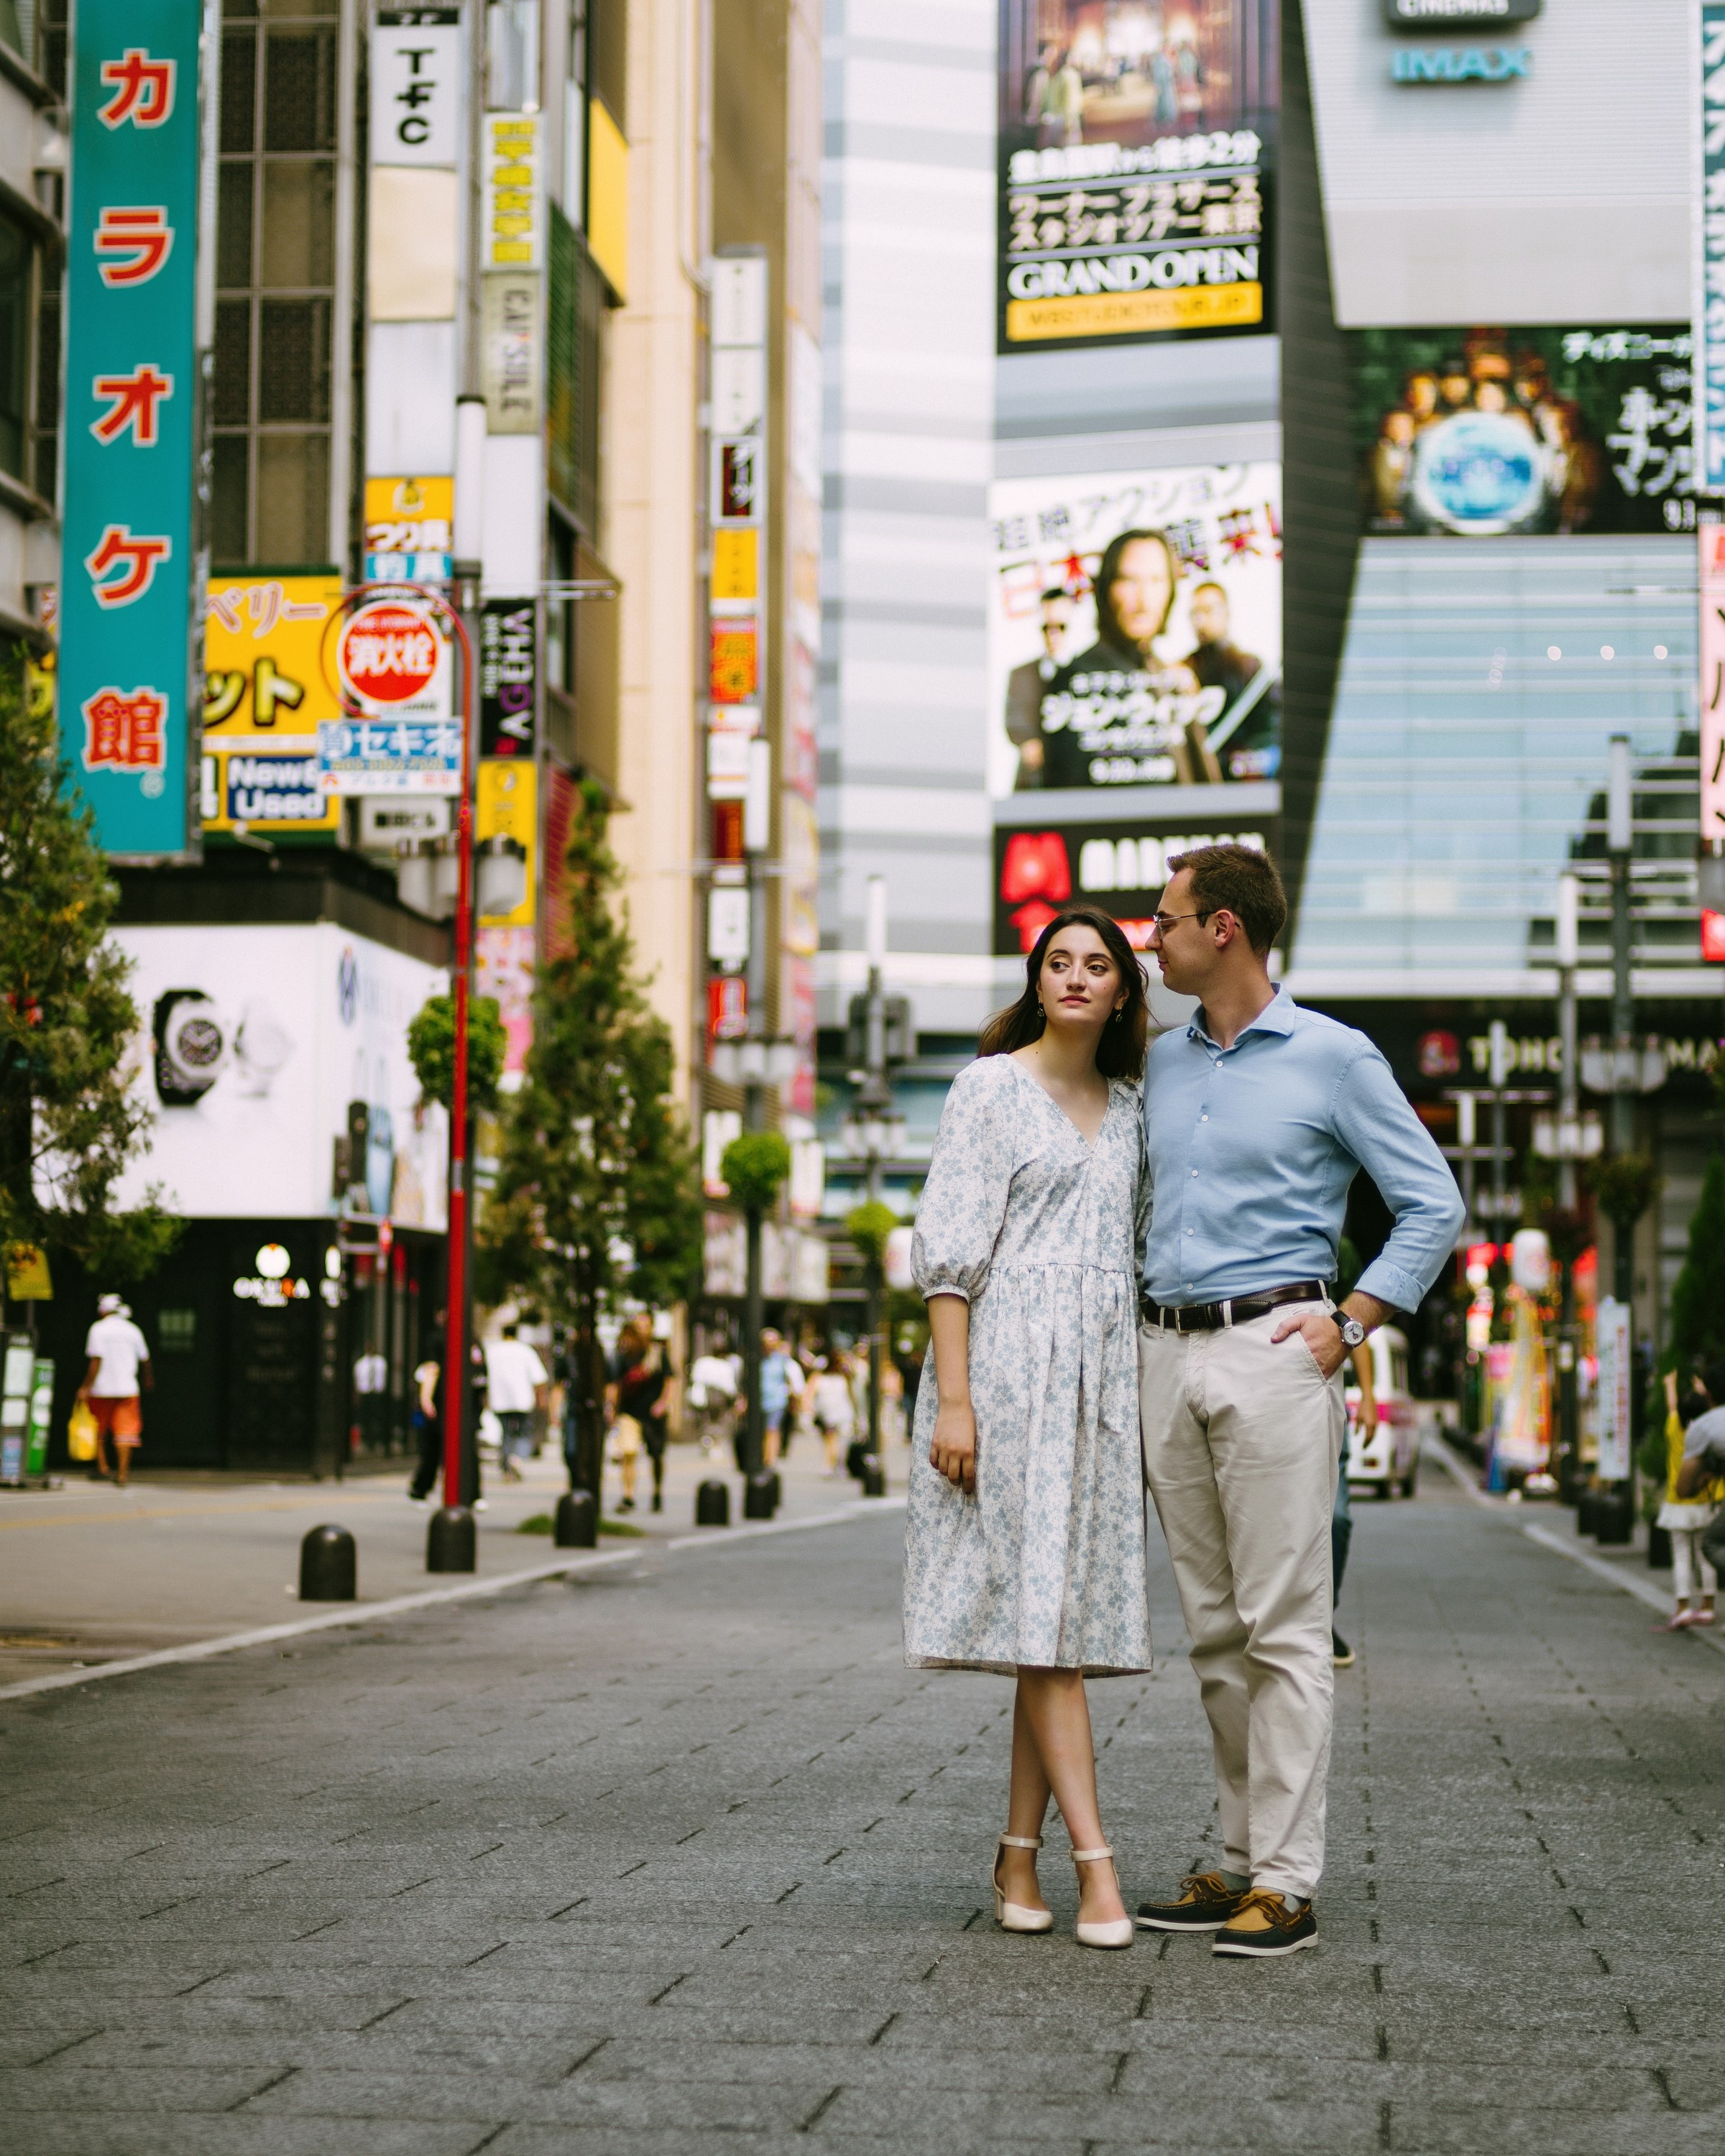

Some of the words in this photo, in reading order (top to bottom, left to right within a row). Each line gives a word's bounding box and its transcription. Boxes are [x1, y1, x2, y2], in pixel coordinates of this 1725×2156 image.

[1392, 47, 1533, 81] IMAX
[1007, 253, 1152, 300] GRAND
[1151, 244, 1259, 290] OPEN
[81, 47, 178, 774] カラオケ館
[348, 631, 434, 678] 消火栓
[234, 787, 326, 819] Used
